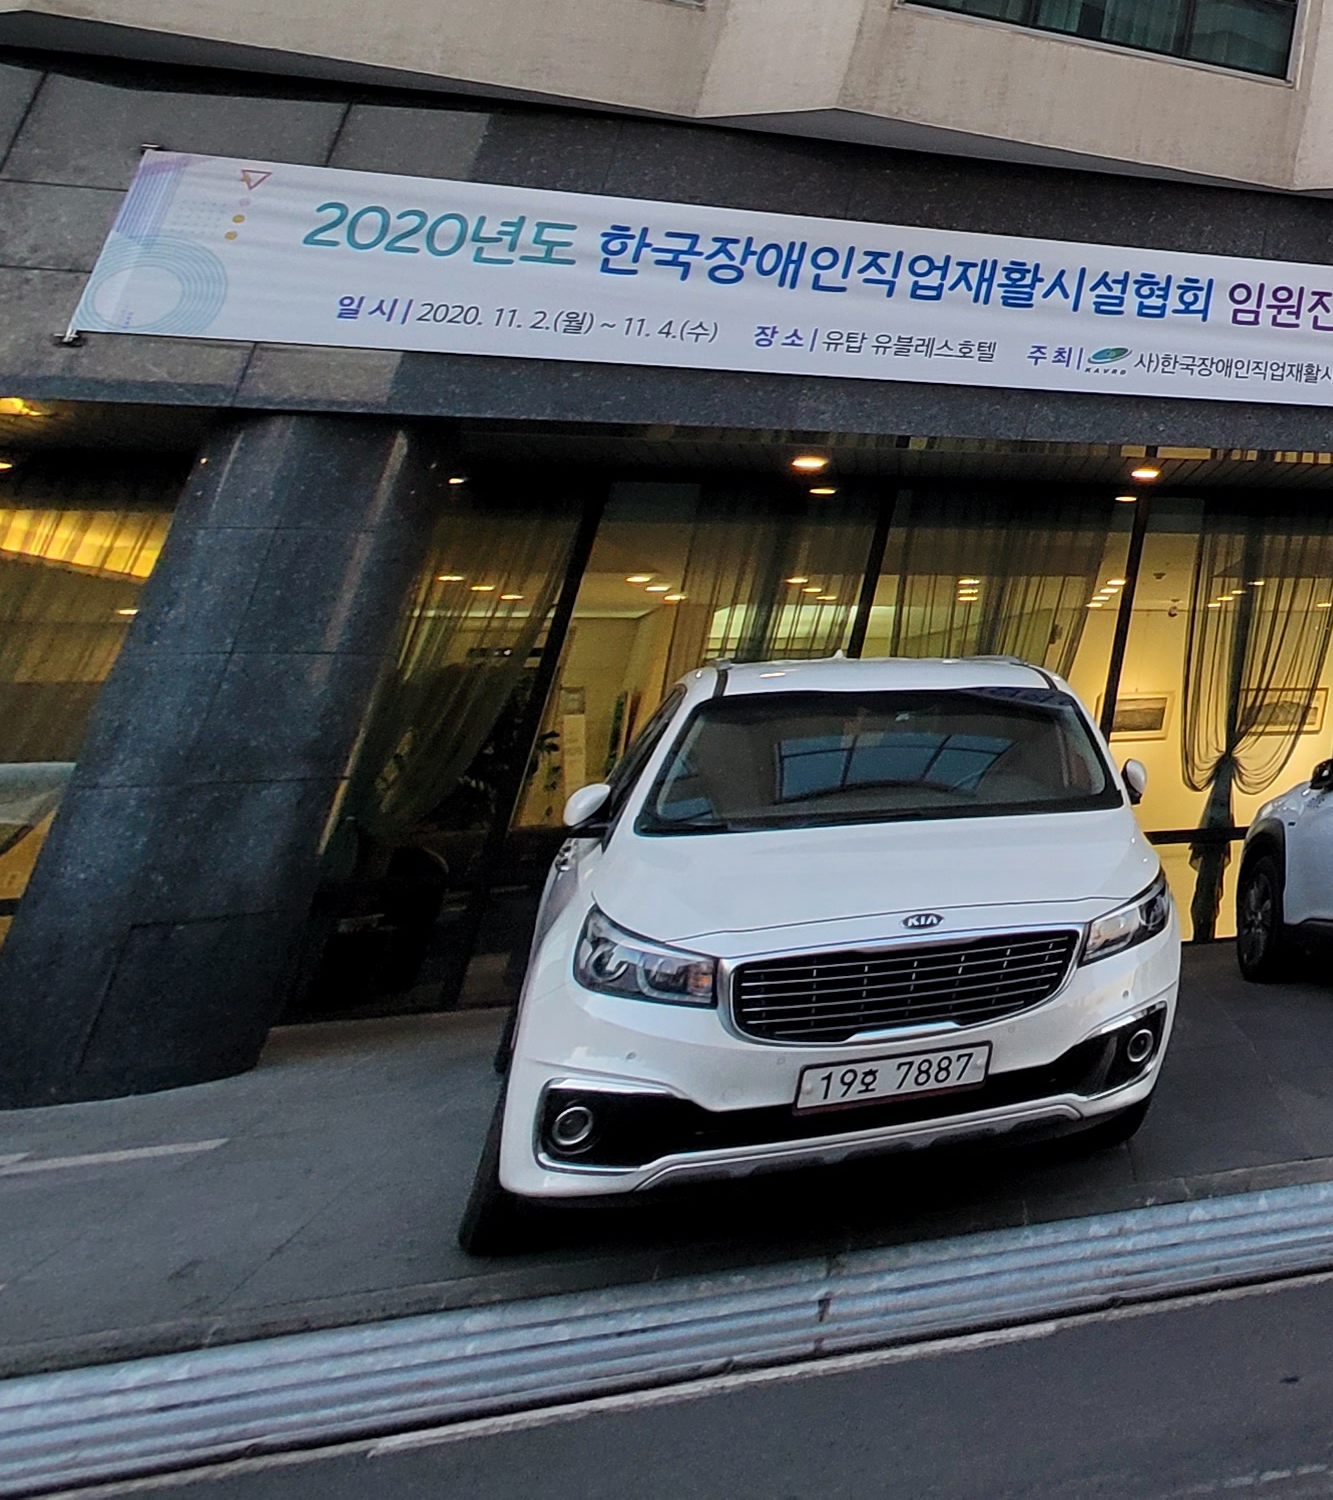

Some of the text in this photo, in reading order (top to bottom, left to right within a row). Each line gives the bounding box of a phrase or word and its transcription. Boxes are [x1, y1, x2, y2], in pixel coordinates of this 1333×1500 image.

[303, 201, 578, 266] 2020년도
[599, 224, 1215, 322] 한국장애인직업재활시설협회
[821, 330, 868, 354] 유탑
[871, 332, 997, 363] 유블레스호텔
[907, 914, 938, 927] KIA
[820, 1051, 975, 1100] 19호 7887
